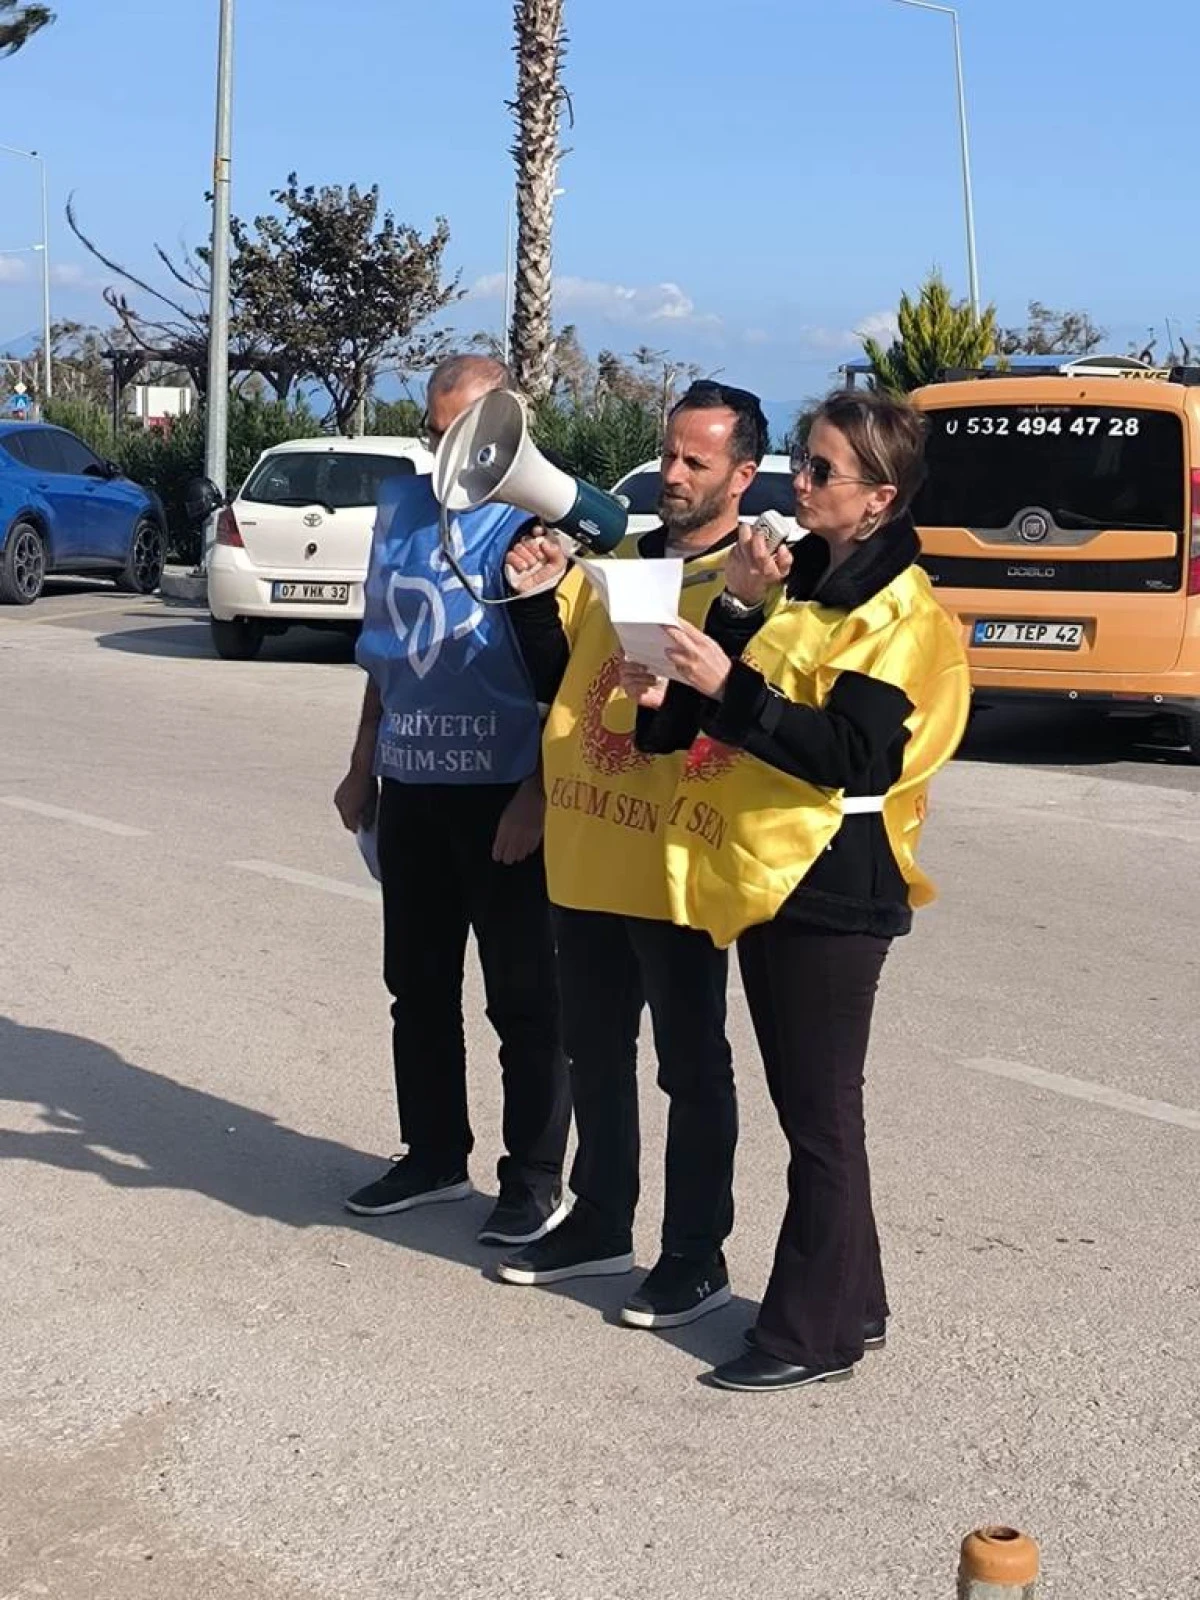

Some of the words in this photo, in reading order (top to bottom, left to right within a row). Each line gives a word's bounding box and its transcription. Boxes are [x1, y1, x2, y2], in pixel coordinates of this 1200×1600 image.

[966, 416, 1009, 436] 532
[1016, 416, 1062, 436] 494
[1069, 416, 1101, 437] 47
[1107, 417, 1140, 437] 28
[282, 585, 296, 597] 07
[302, 585, 326, 598] VHK
[330, 586, 346, 599] 32
[983, 624, 1007, 640] 07
[1015, 624, 1048, 641] TEP
[1055, 626, 1079, 643] 42
[612, 793, 661, 833] SEN
[685, 800, 728, 851] SEN
